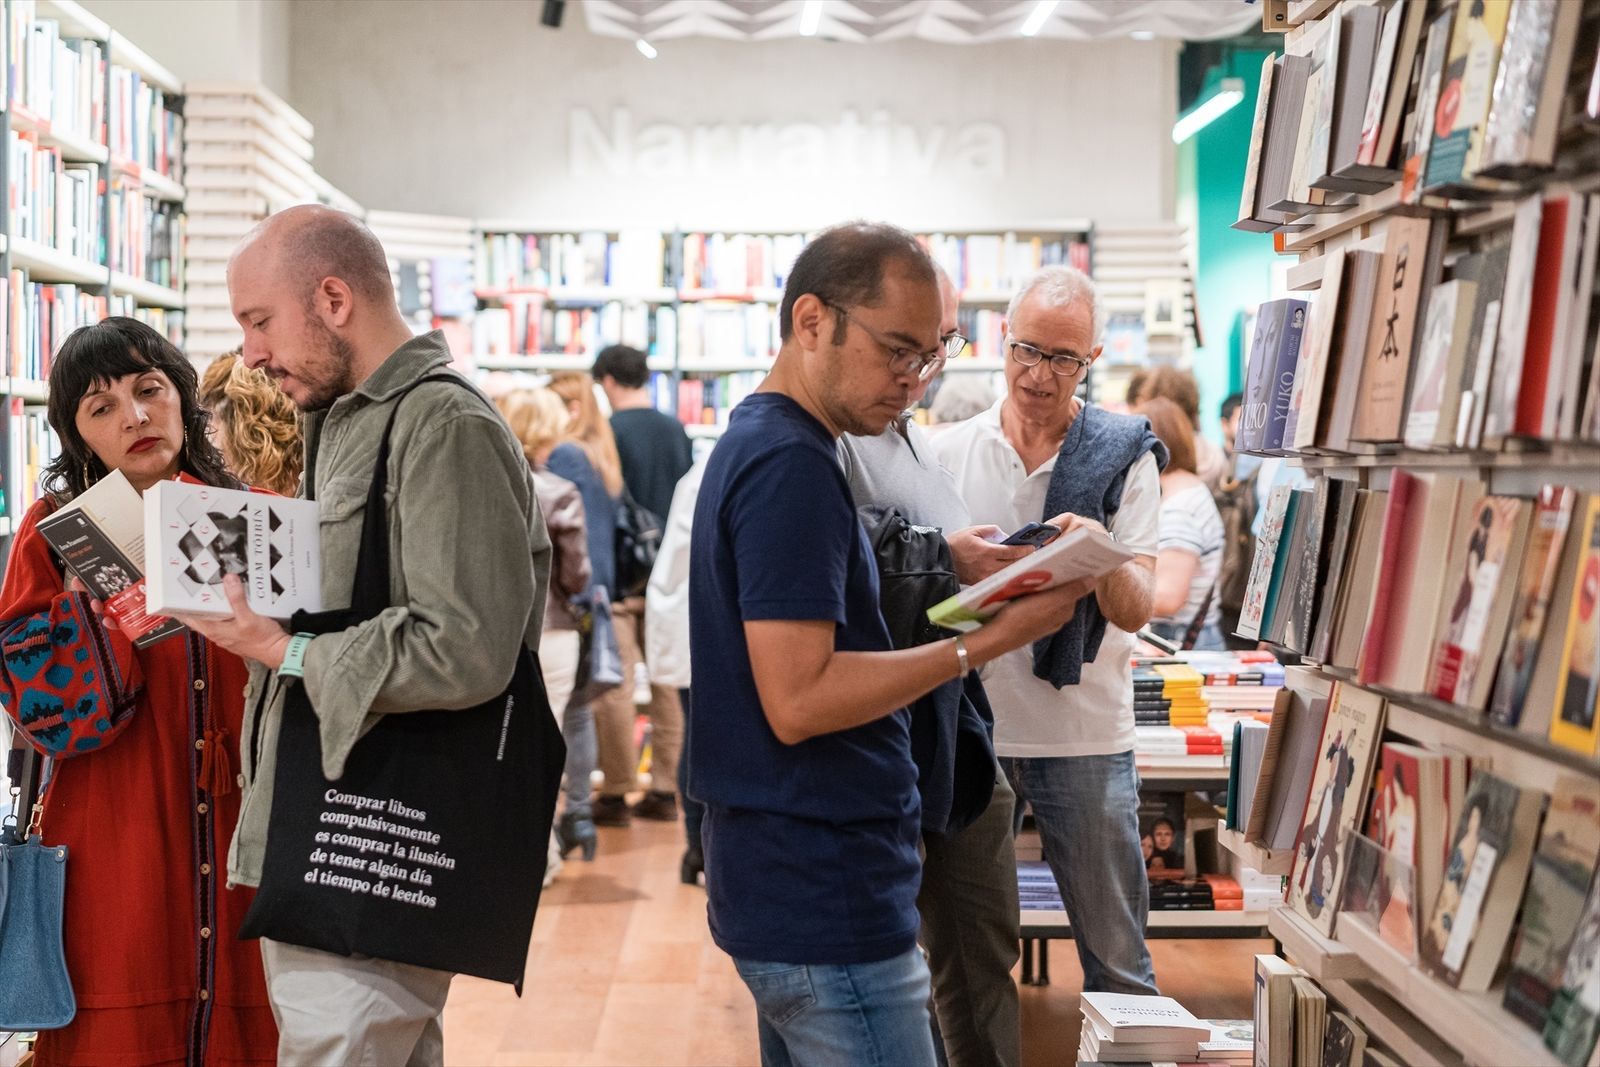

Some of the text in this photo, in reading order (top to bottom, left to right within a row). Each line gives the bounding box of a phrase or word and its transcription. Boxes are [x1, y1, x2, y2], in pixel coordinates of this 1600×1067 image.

[567, 104, 1008, 177] Narrativa
[1239, 402, 1267, 429] YUKO
[1273, 371, 1294, 422] YUKO
[254, 561, 266, 599] COLM
[324, 788, 427, 822] Comprar libros
[320, 809, 441, 845] compulsivamente
[309, 848, 433, 887] de tener algún día
[314, 830, 456, 870] es comprar la ilusión
[304, 869, 437, 909] el tiempo de leerlos
